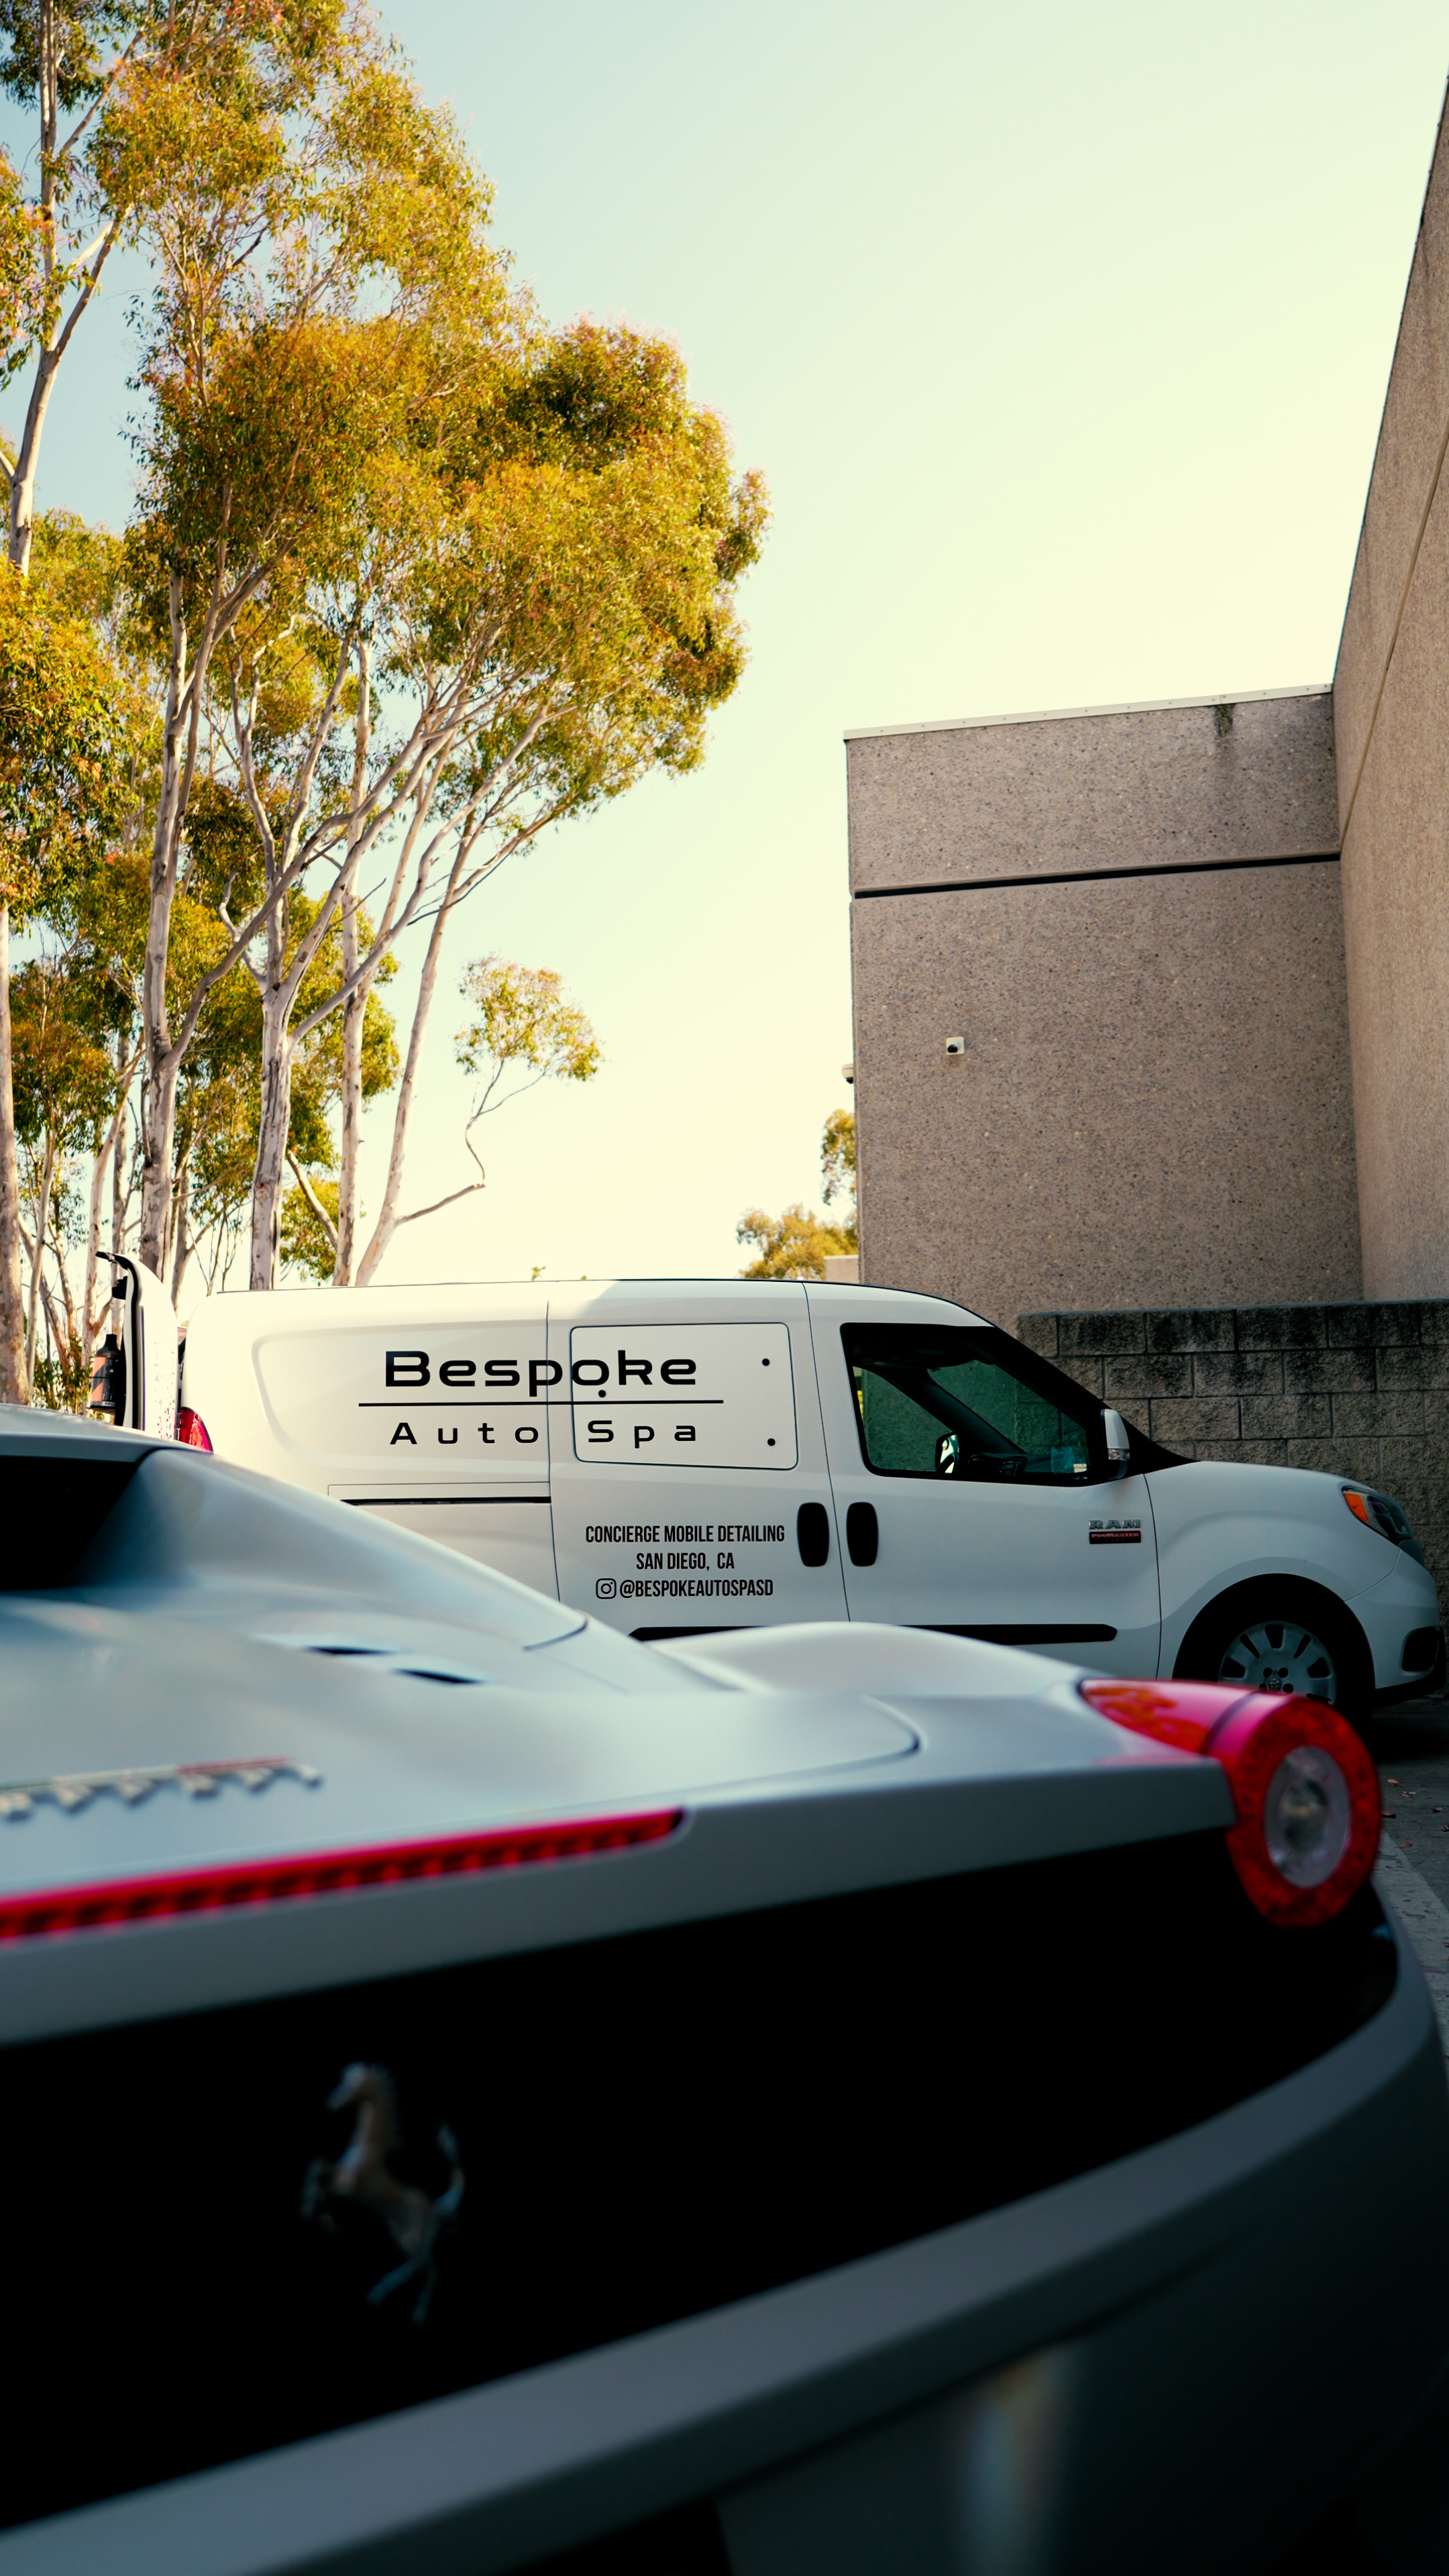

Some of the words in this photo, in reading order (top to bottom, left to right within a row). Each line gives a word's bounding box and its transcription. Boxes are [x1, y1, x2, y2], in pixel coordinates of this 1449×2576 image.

[385, 1350, 697, 1397] Bespoke
[390, 1422, 539, 1445] Auto
[587, 1420, 697, 1448] Spa
[585, 1525, 660, 1543] CONCIERGE
[664, 1525, 714, 1543] MOBILE
[718, 1525, 785, 1542] DETAILING
[1088, 1519, 1141, 1529] RAM
[636, 1552, 663, 1570] SAN
[667, 1552, 710, 1572] DIEGO,
[716, 1552, 735, 1570] CA
[619, 1578, 774, 1599] @BESPOKEAUTOSPASD
